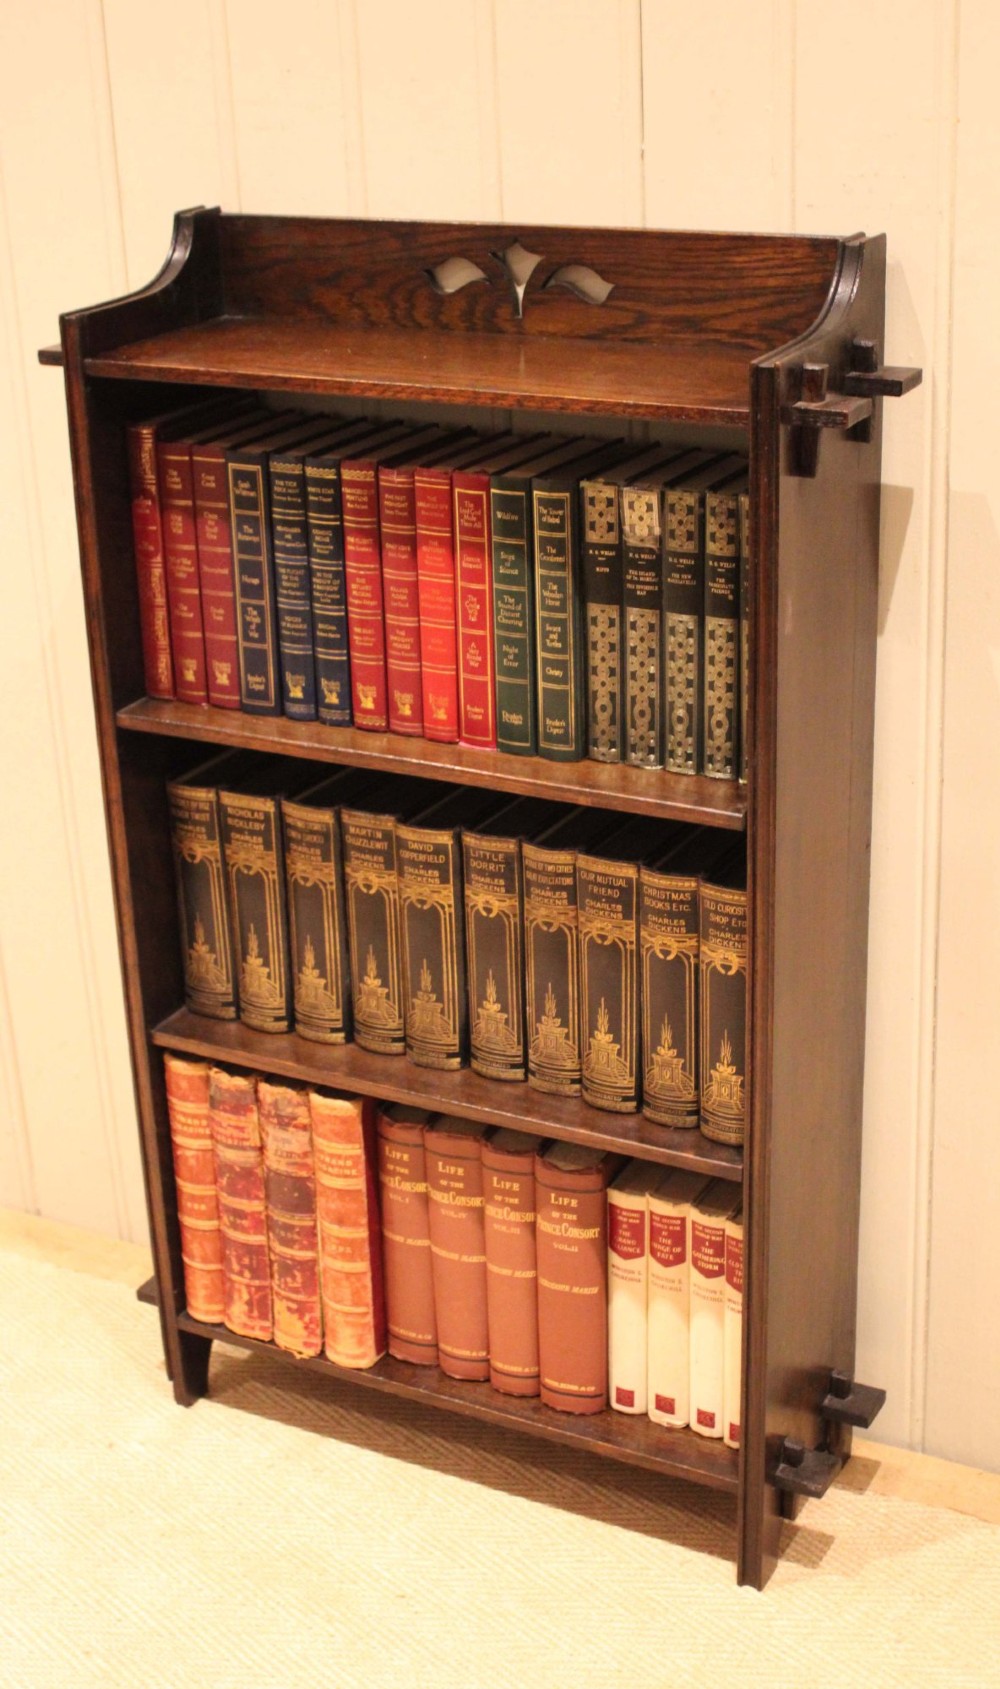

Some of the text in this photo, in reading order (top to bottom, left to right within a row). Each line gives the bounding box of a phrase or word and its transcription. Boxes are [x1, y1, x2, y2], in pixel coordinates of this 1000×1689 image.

[496, 512, 519, 521] Wildfire
[228, 807, 264, 819] NICHOLAS
[227, 817, 265, 830] NICKLEBY
[231, 832, 263, 843] CHARLES
[350, 826, 382, 839] MARTIN
[345, 835, 388, 850] CHUZZLEWIT
[408, 841, 433, 851] DAVID
[352, 851, 384, 863] CHARLES
[400, 850, 445, 863] COPPERFIELD
[470, 850, 504, 861] LITTLE
[352, 859, 385, 870] DICKENS
[470, 860, 506, 872] DORRIT
[404, 866, 439, 876] CHARLES
[404, 874, 440, 884] DICKENS
[472, 874, 504, 885] CHARLES
[581, 871, 628, 888] OUR MUTUAL
[472, 881, 505, 893] DICKENS
[531, 887, 567, 898] CHARLES
[588, 885, 619, 898] FRIEND
[643, 886, 691, 901] CHRISTMAS
[531, 894, 568, 906] DICKENS
[586, 900, 622, 912] CHARLES
[644, 896, 670, 910] BOOKS
[704, 899, 715, 910] OLD
[586, 908, 623, 920] DICKENS
[648, 914, 685, 925] CHARLES
[709, 913, 728, 925] SHOP
[649, 922, 686, 934] DICKENS
[385, 1146, 409, 1162] LIFE
[395, 1166, 409, 1174] THE
[438, 1162, 464, 1176] LIFE
[450, 1180, 464, 1189] THE
[493, 1177, 520, 1192] LIFE
[450, 1192, 484, 1208] CONSORT
[504, 1195, 519, 1204] THE
[551, 1194, 578, 1208] LIFE
[537, 1214, 599, 1239] PRINCE CONSORT
[553, 1242, 569, 1250] VOL.
[657, 1251, 674, 1260] FATE
[697, 1261, 719, 1271] STORM
[571, 1286, 599, 1295] MARTIN
